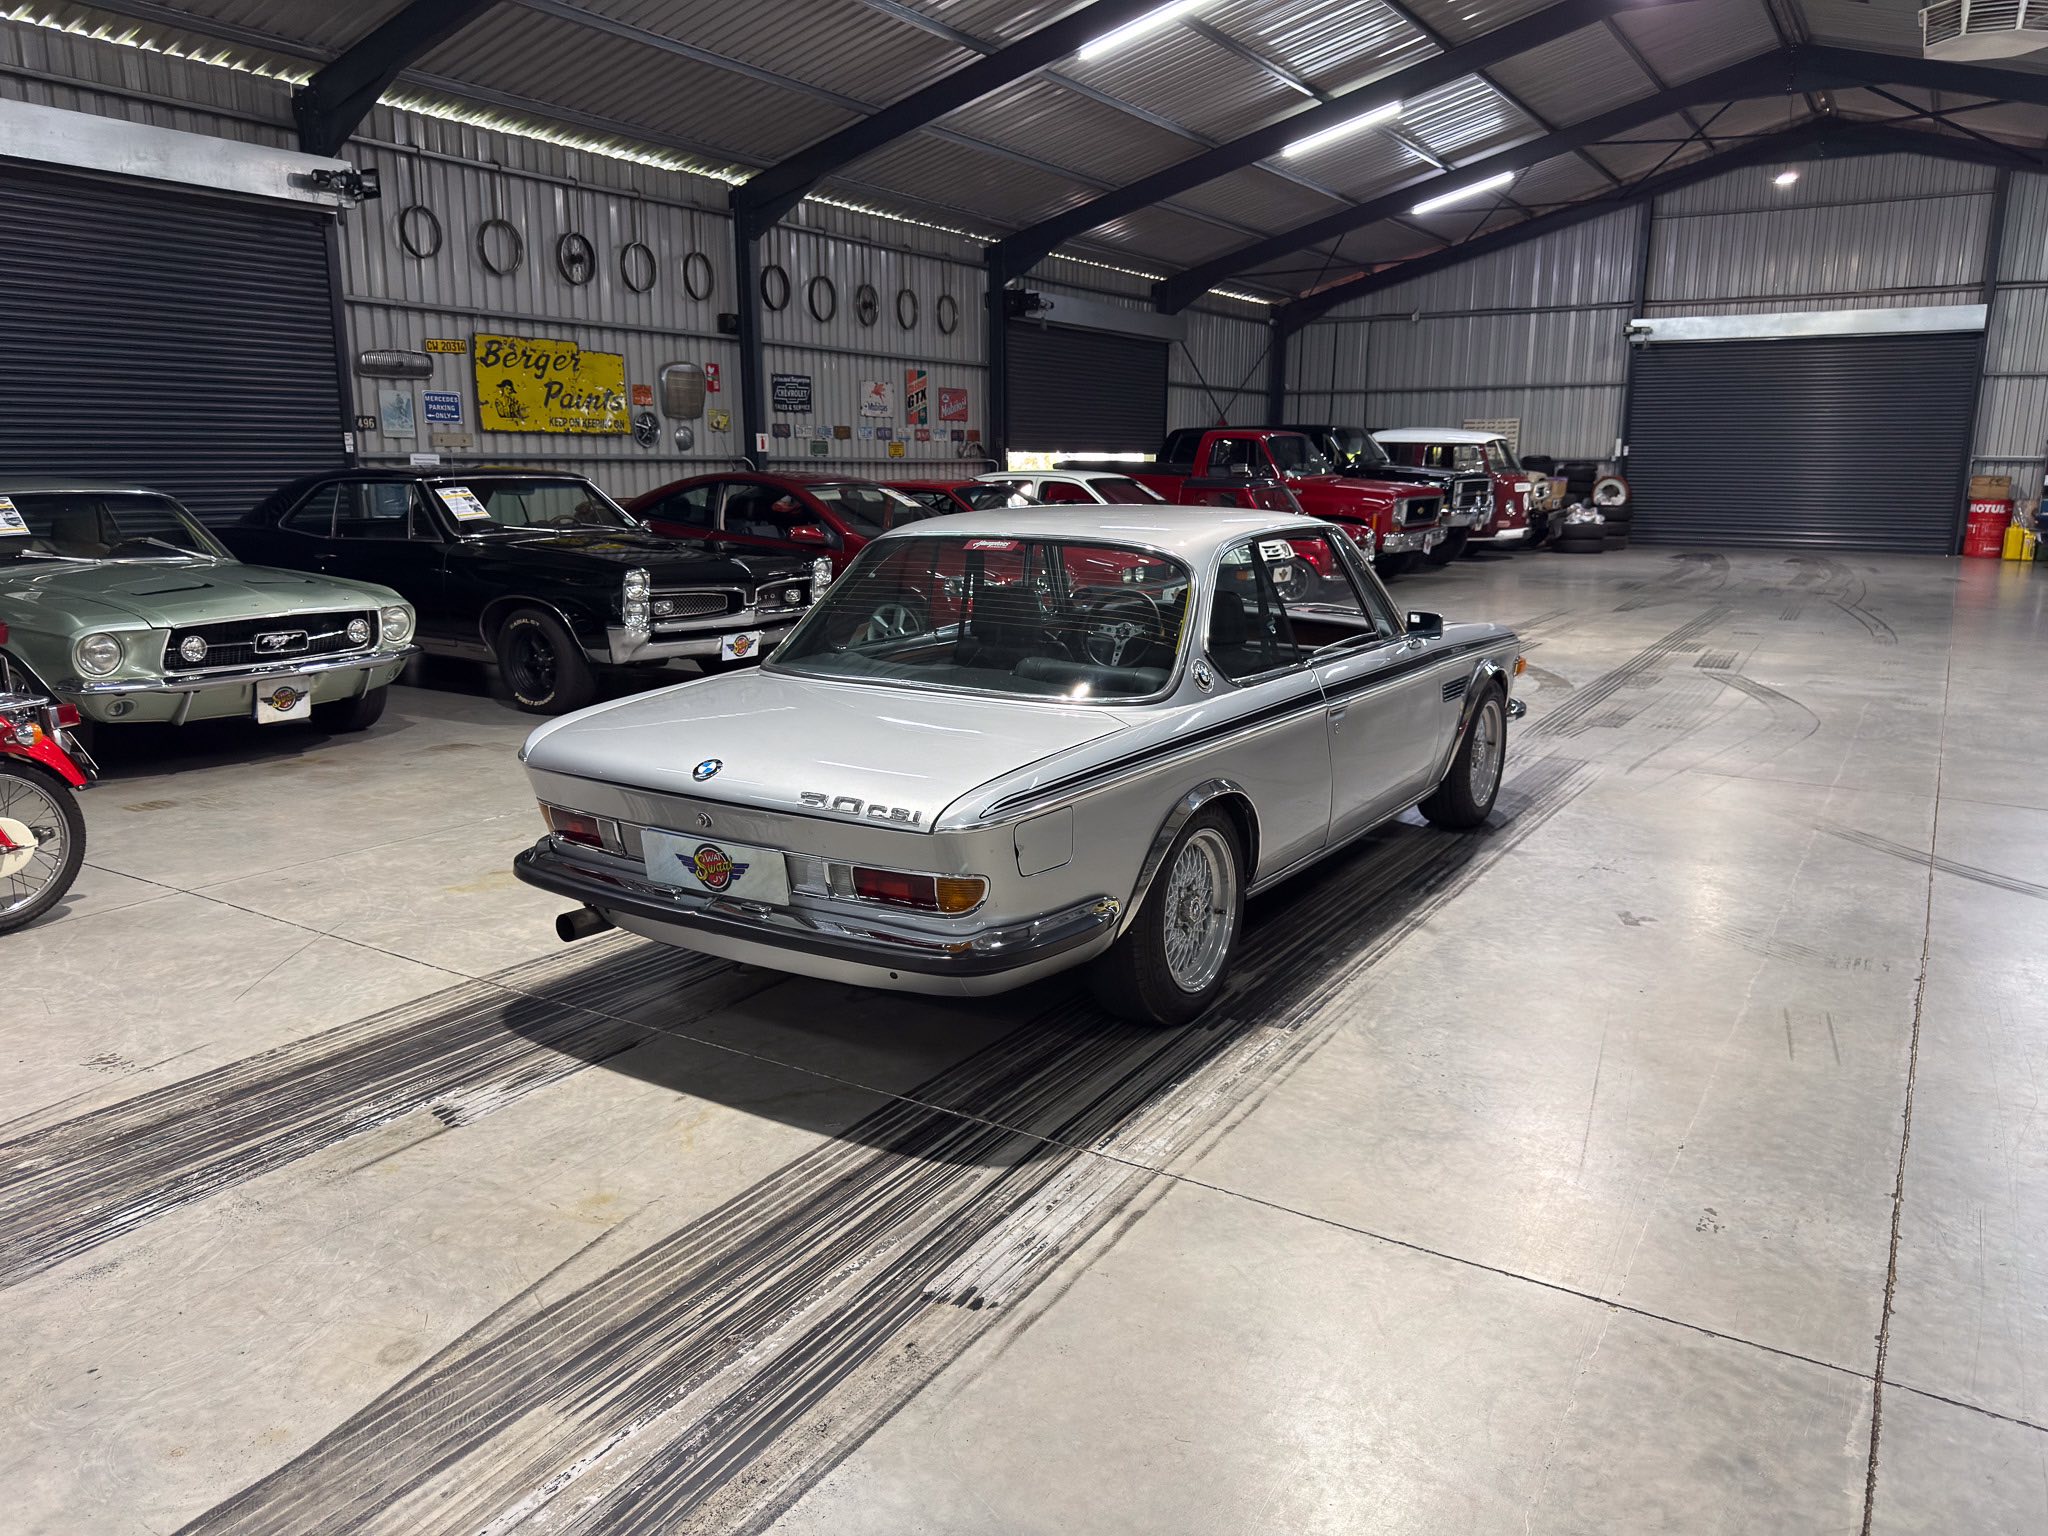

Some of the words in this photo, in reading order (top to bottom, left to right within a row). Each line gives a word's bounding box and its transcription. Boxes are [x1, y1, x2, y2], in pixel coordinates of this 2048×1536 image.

[426, 341, 438, 351] CW
[441, 341, 465, 351] 20314
[480, 339, 581, 379] Berger
[543, 381, 624, 411] Paints
[777, 389, 808, 398] CHEVROLET
[908, 387, 927, 409] GTX
[424, 395, 459, 403] MERCEDES
[357, 418, 375, 428] 496
[550, 416, 568, 427] KEEP
[569, 417, 581, 427] ON
[614, 419, 625, 429] ON
[713, 875, 724, 883] JY
